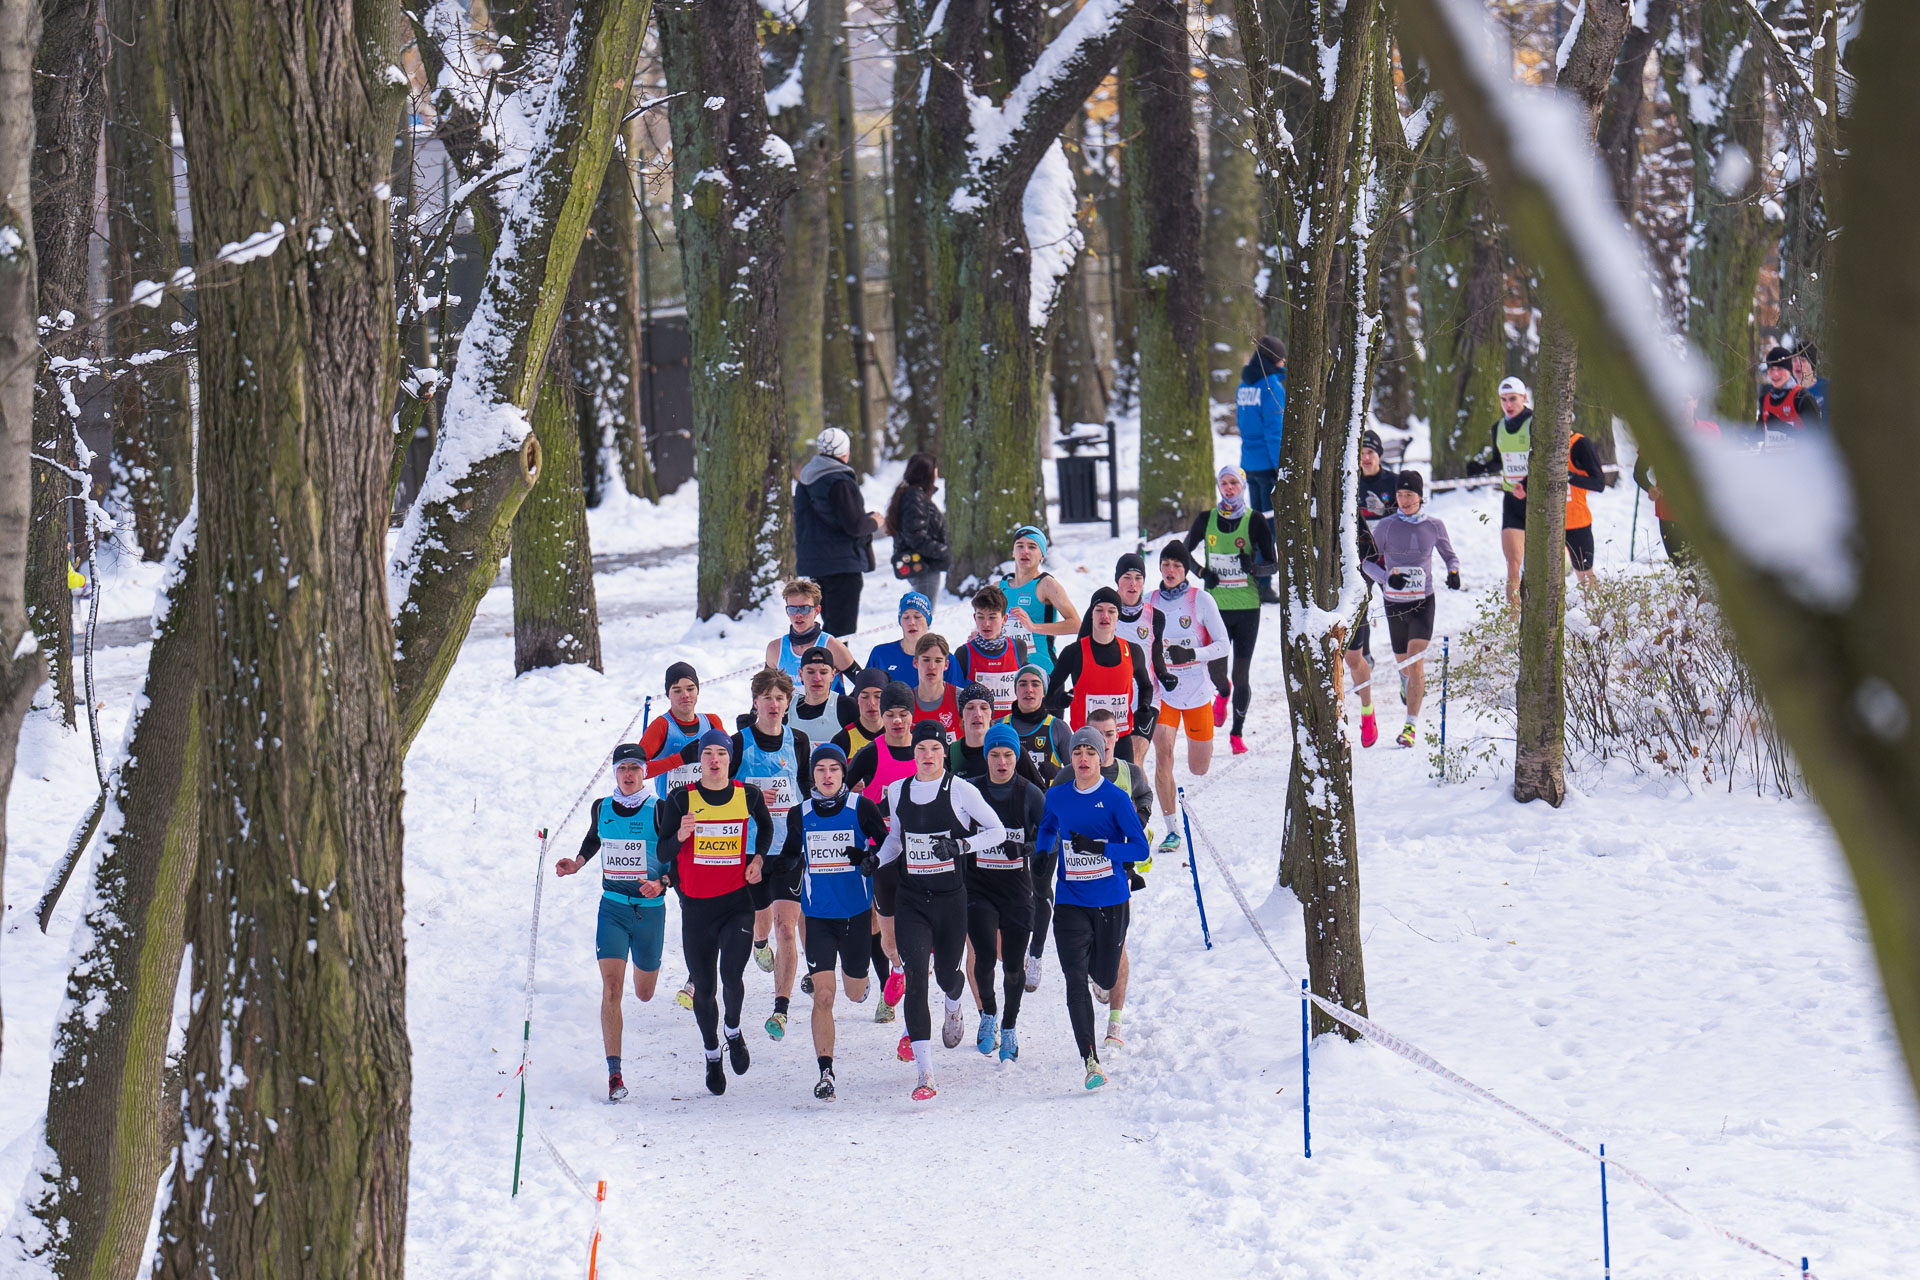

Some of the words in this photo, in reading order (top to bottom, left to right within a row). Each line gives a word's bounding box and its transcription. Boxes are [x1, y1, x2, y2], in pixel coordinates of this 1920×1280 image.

[1506, 463, 1528, 473] CERSK
[1405, 580, 1422, 588] ZAK
[1180, 638, 1191, 646] 49
[991, 688, 1010, 697] ALIK
[1111, 697, 1126, 706] 212
[693, 765, 703, 774] 66
[772, 780, 787, 788] 263
[776, 793, 790, 803] KA
[722, 825, 739, 835] 516
[832, 833, 850, 842] 682
[624, 842, 642, 851] 689
[698, 840, 738, 851] ZACZYK
[810, 848, 847, 859] PECYN
[982, 846, 1006, 855] GAW
[606, 855, 642, 866] JAROSZ
